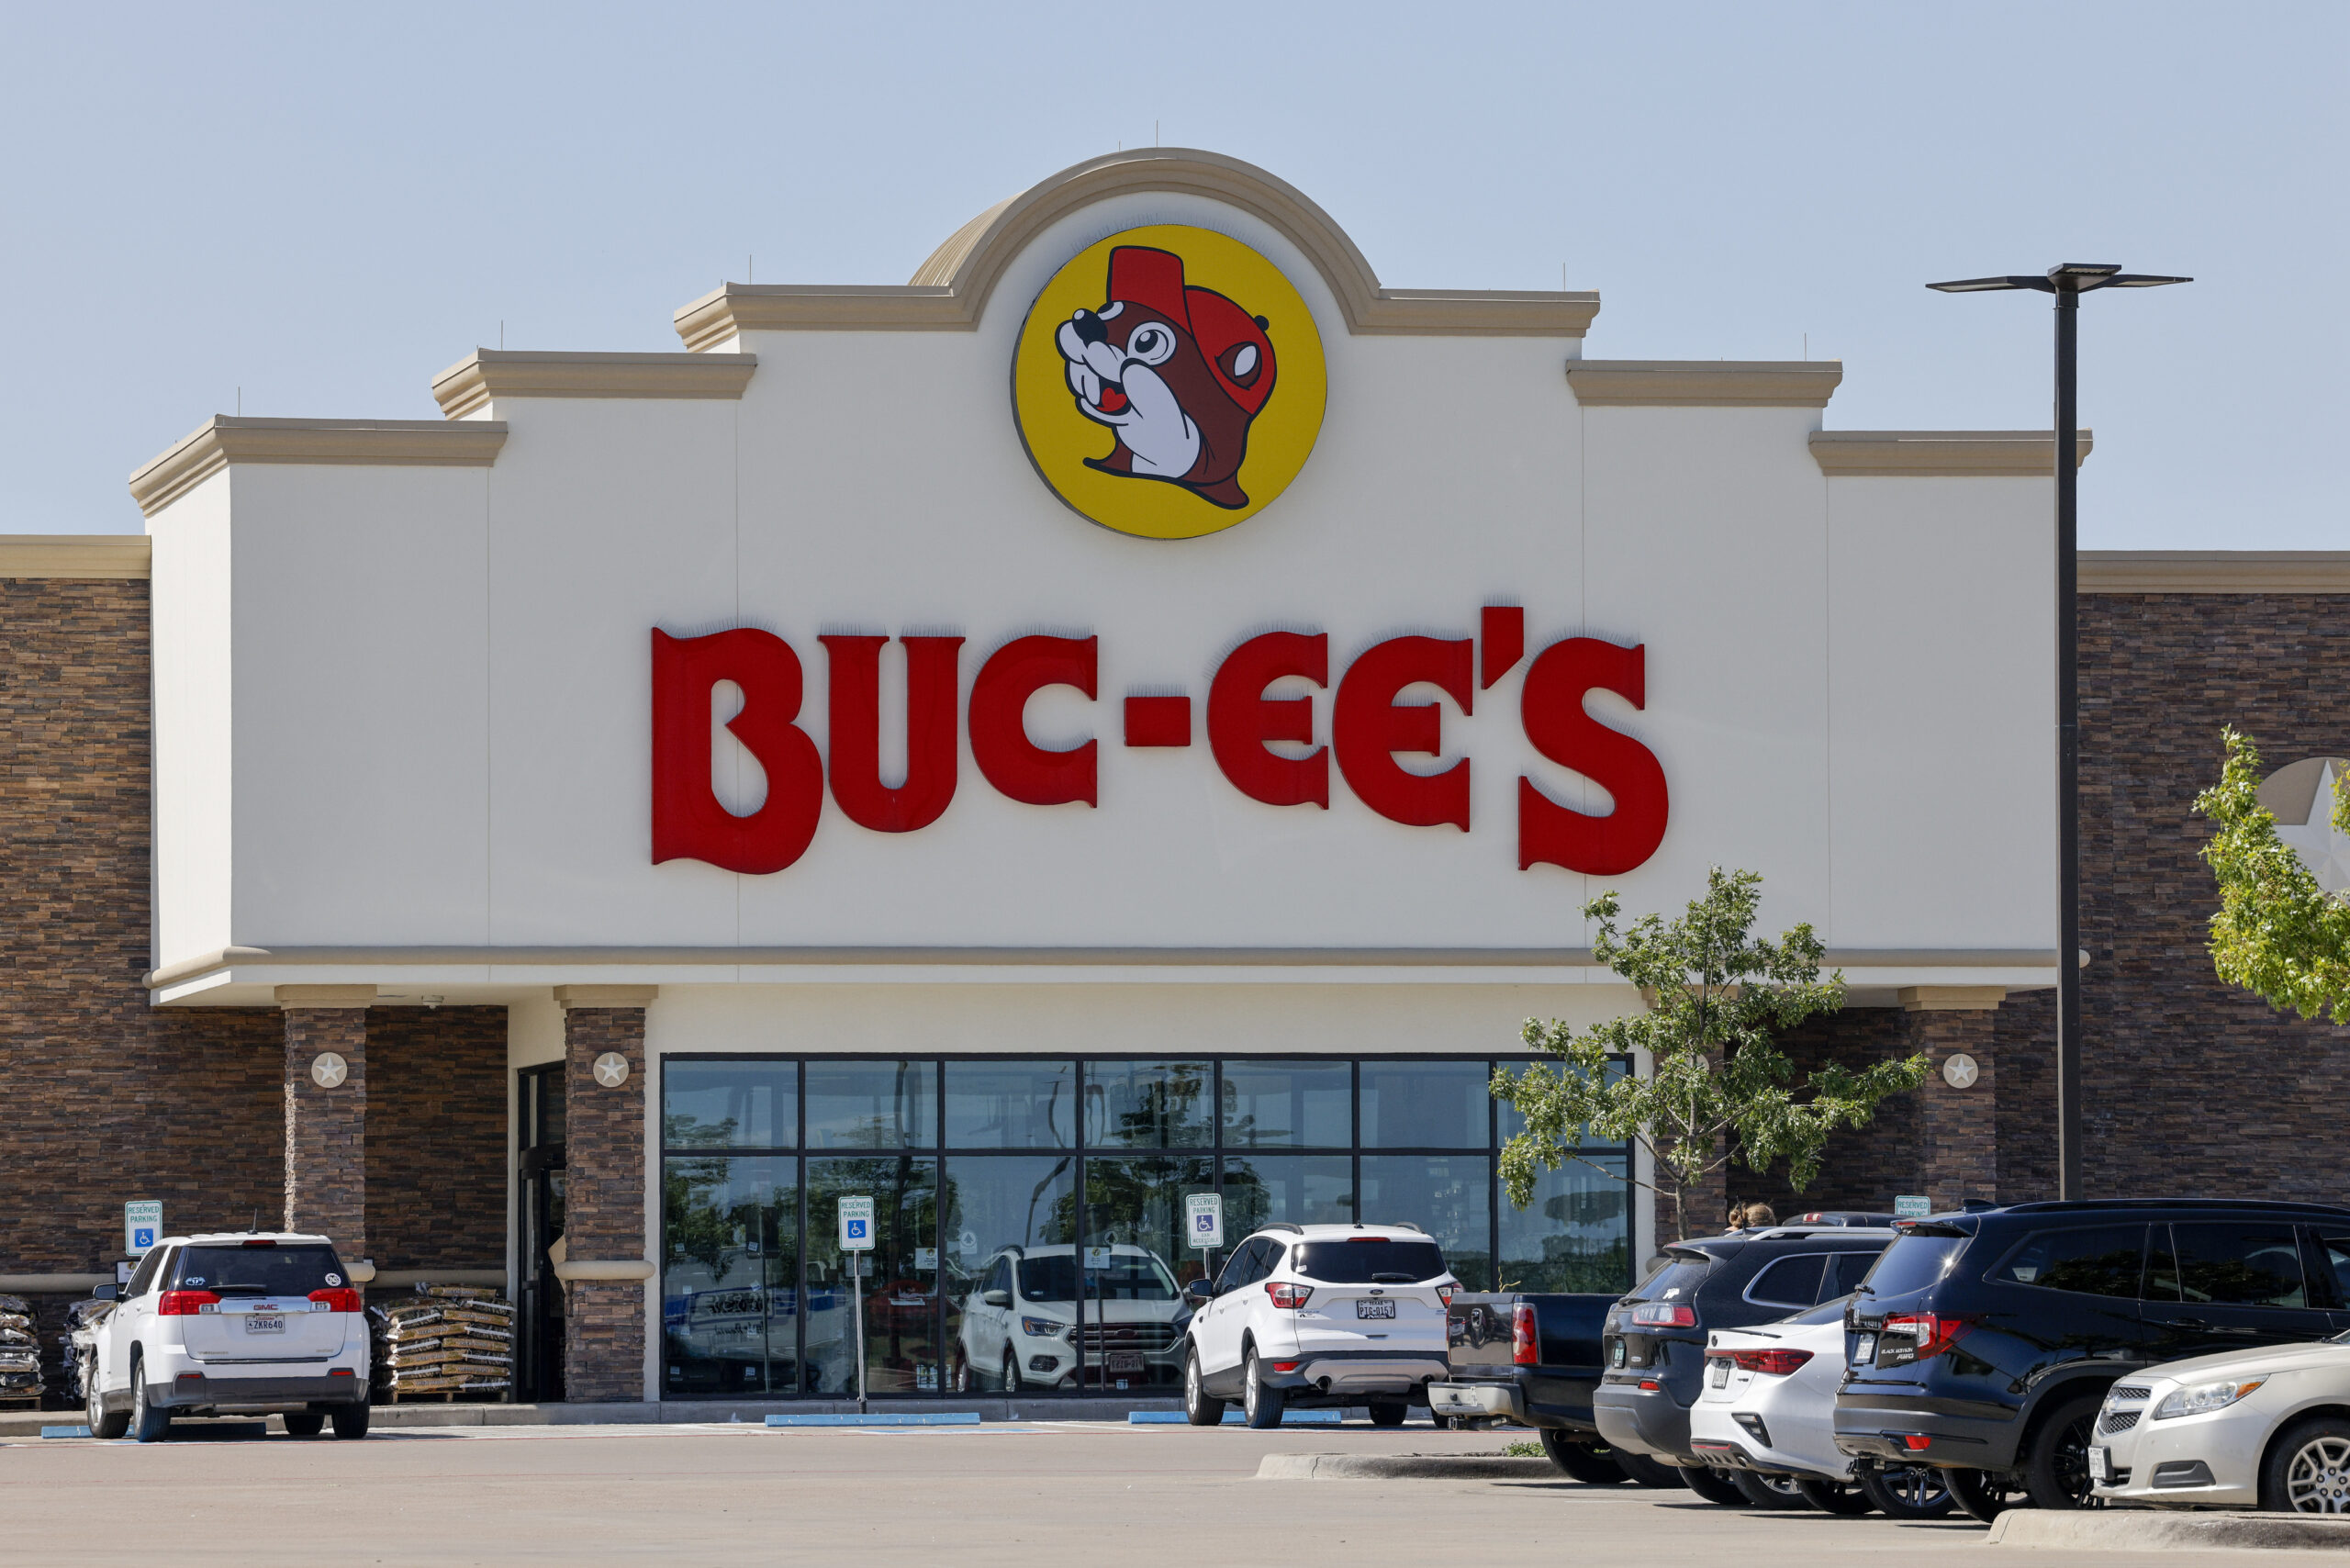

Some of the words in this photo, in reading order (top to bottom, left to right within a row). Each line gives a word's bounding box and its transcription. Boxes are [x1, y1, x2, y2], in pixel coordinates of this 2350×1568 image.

[651, 606, 1669, 876] BUC-EE'S
[841, 1201, 871, 1209] RESERVED
[1190, 1197, 1218, 1206] RESERVED
[1897, 1201, 1928, 1209] RESERVED
[844, 1210, 870, 1218] PARKING
[130, 1215, 158, 1223] PARKING
